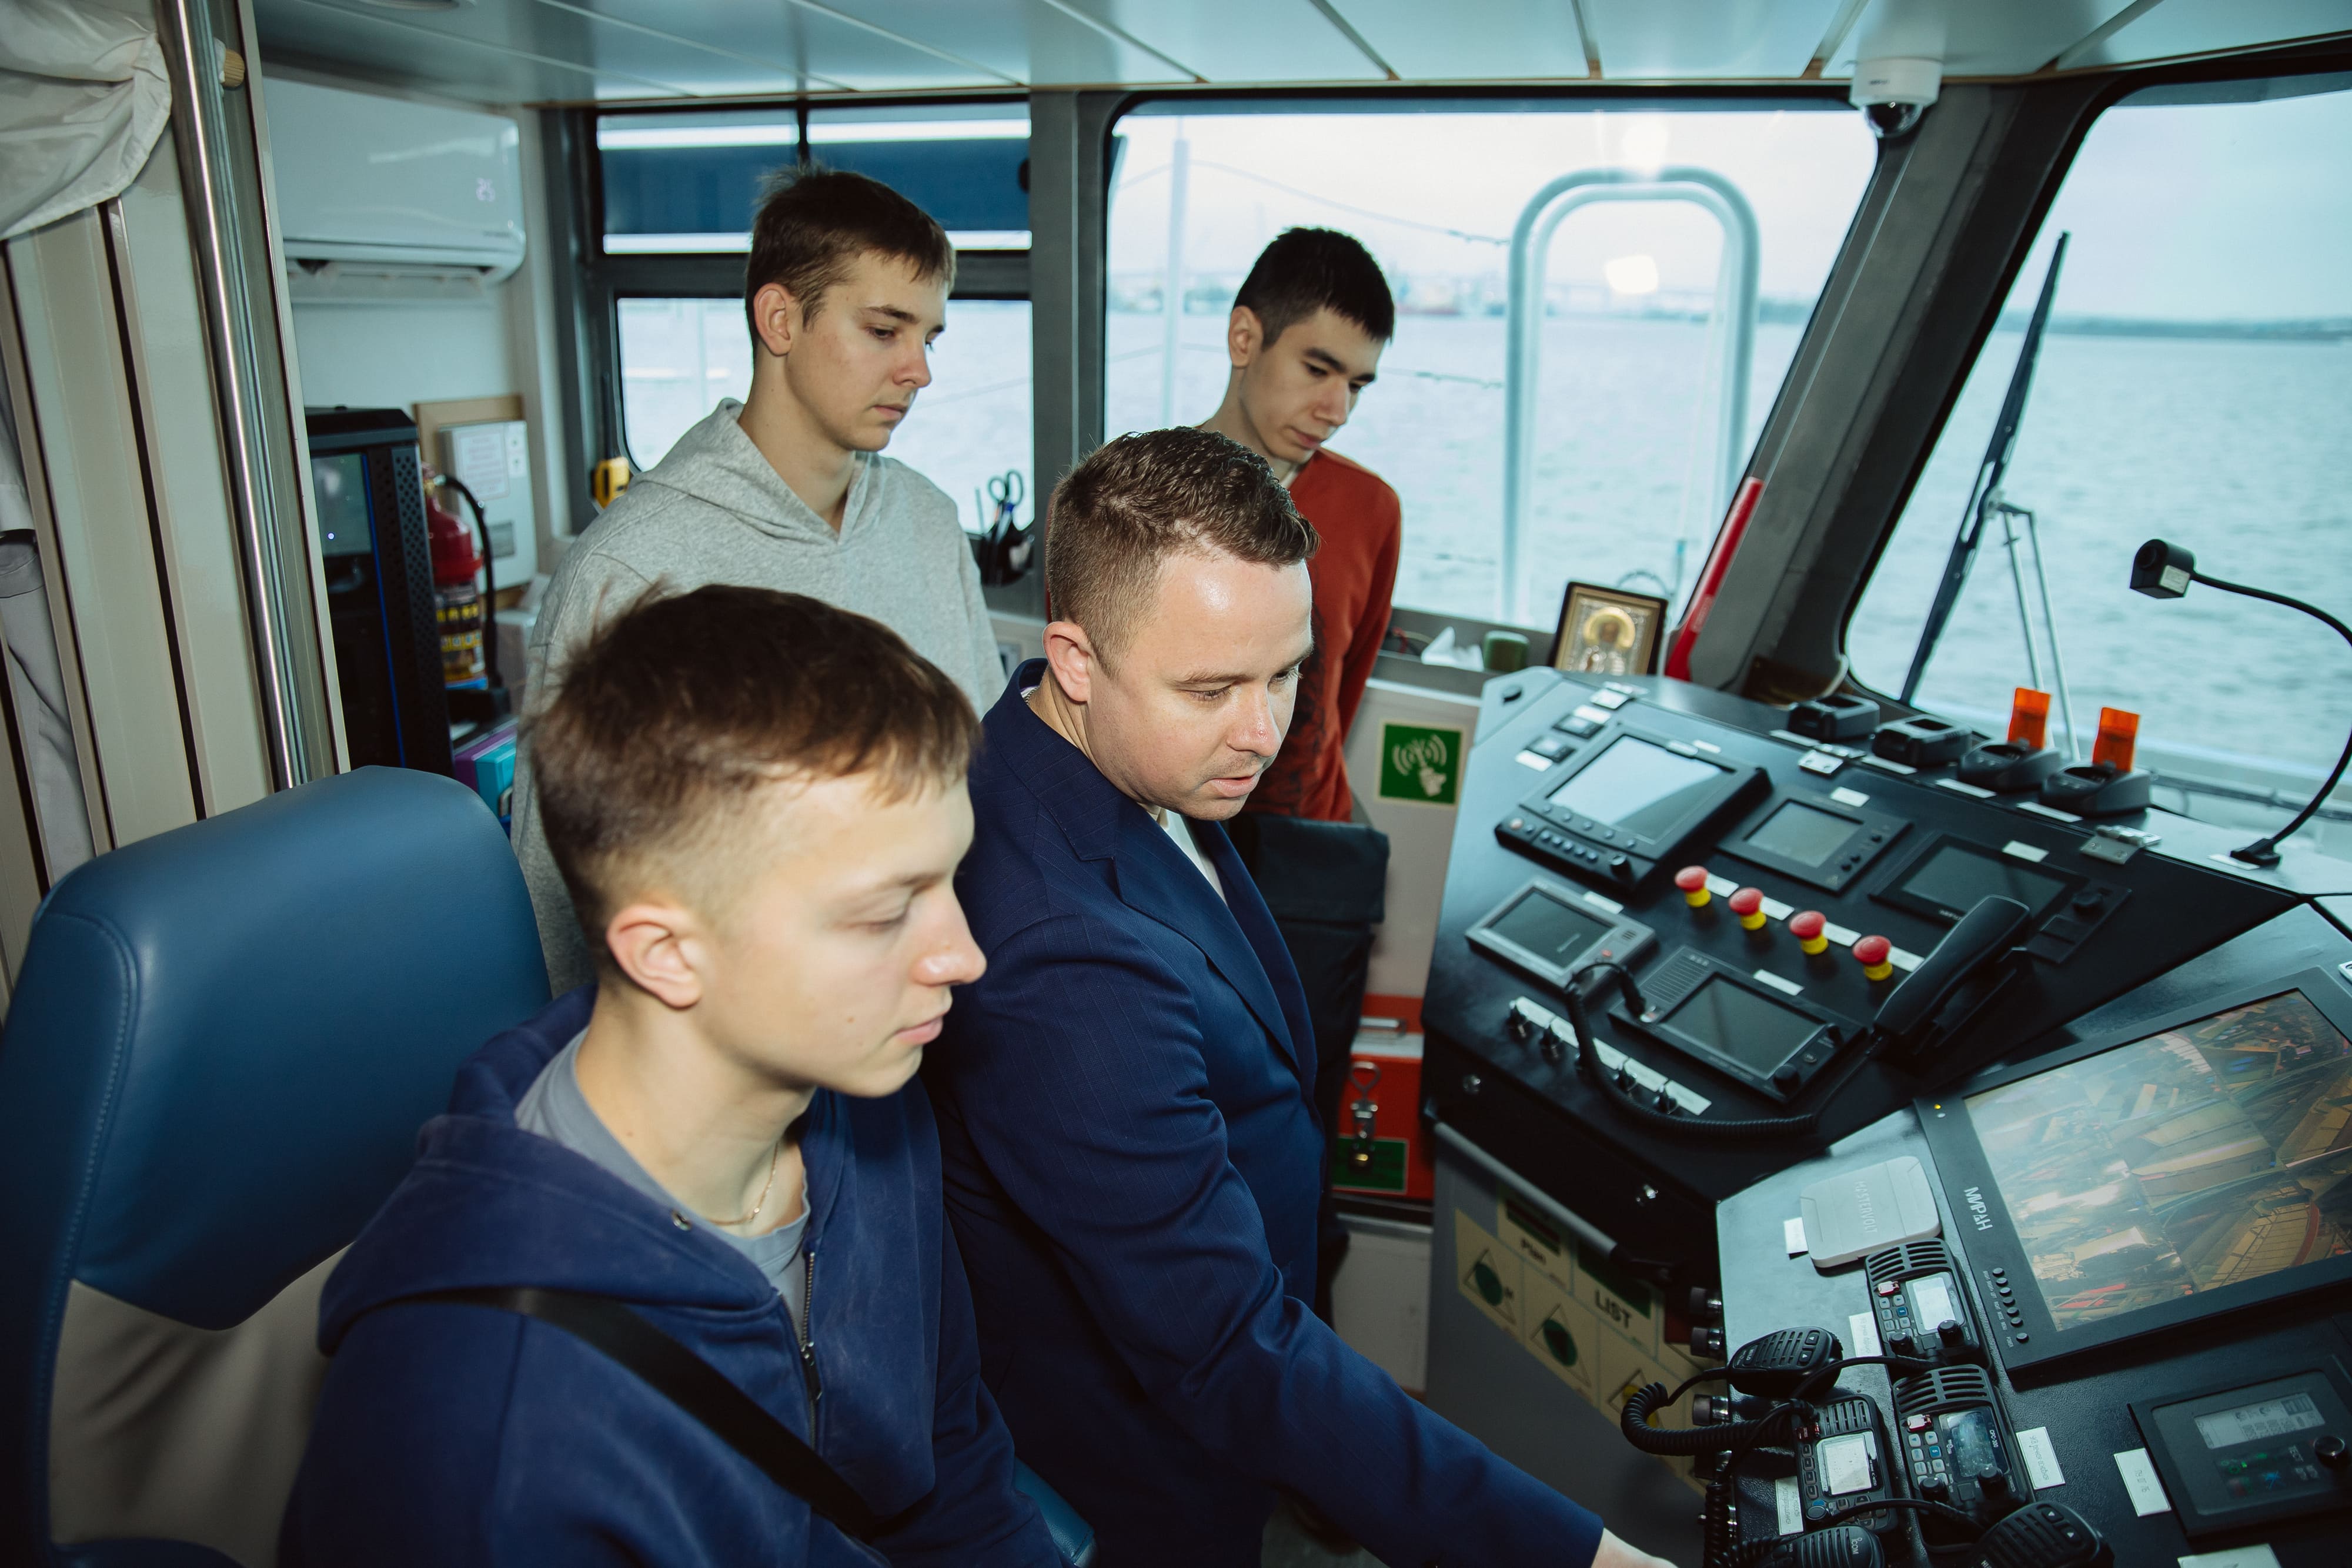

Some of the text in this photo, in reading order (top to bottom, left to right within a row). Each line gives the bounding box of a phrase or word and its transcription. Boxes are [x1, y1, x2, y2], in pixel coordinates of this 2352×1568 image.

[1855, 1181, 1878, 1233] MASTERVOLT
[1594, 1289, 1632, 1329] LIST
[2006, 1336, 2014, 1348] POWER
